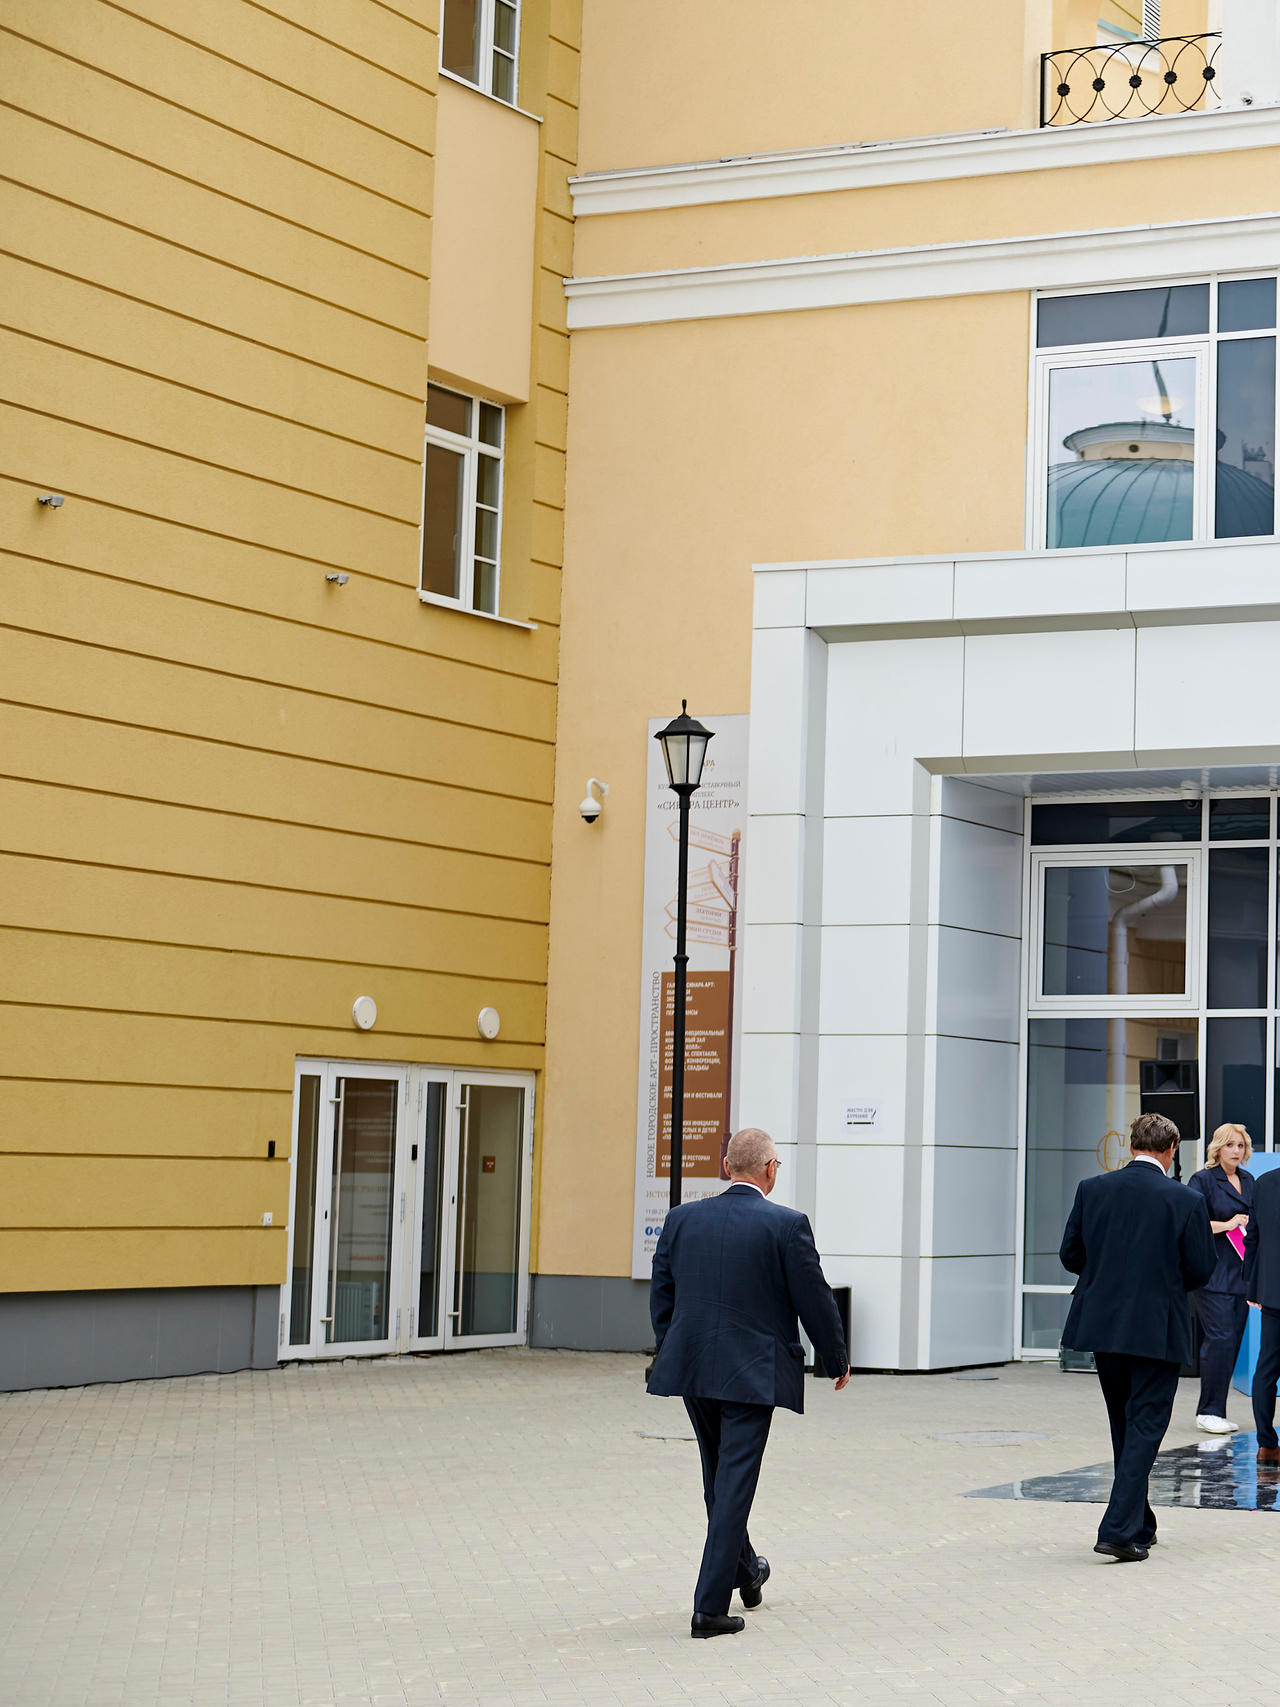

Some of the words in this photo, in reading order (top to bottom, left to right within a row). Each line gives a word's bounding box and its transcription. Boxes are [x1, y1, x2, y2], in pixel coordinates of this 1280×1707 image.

[657, 801, 700, 810] «СИНРА
[702, 800, 740, 810] ЦЕНТР»
[649, 971, 661, 1079] АРТ-ПРОСТРАНСТВО
[647, 1081, 658, 1141] ГОРОДСКОЕ
[646, 1143, 656, 1178] НОВОЕ
